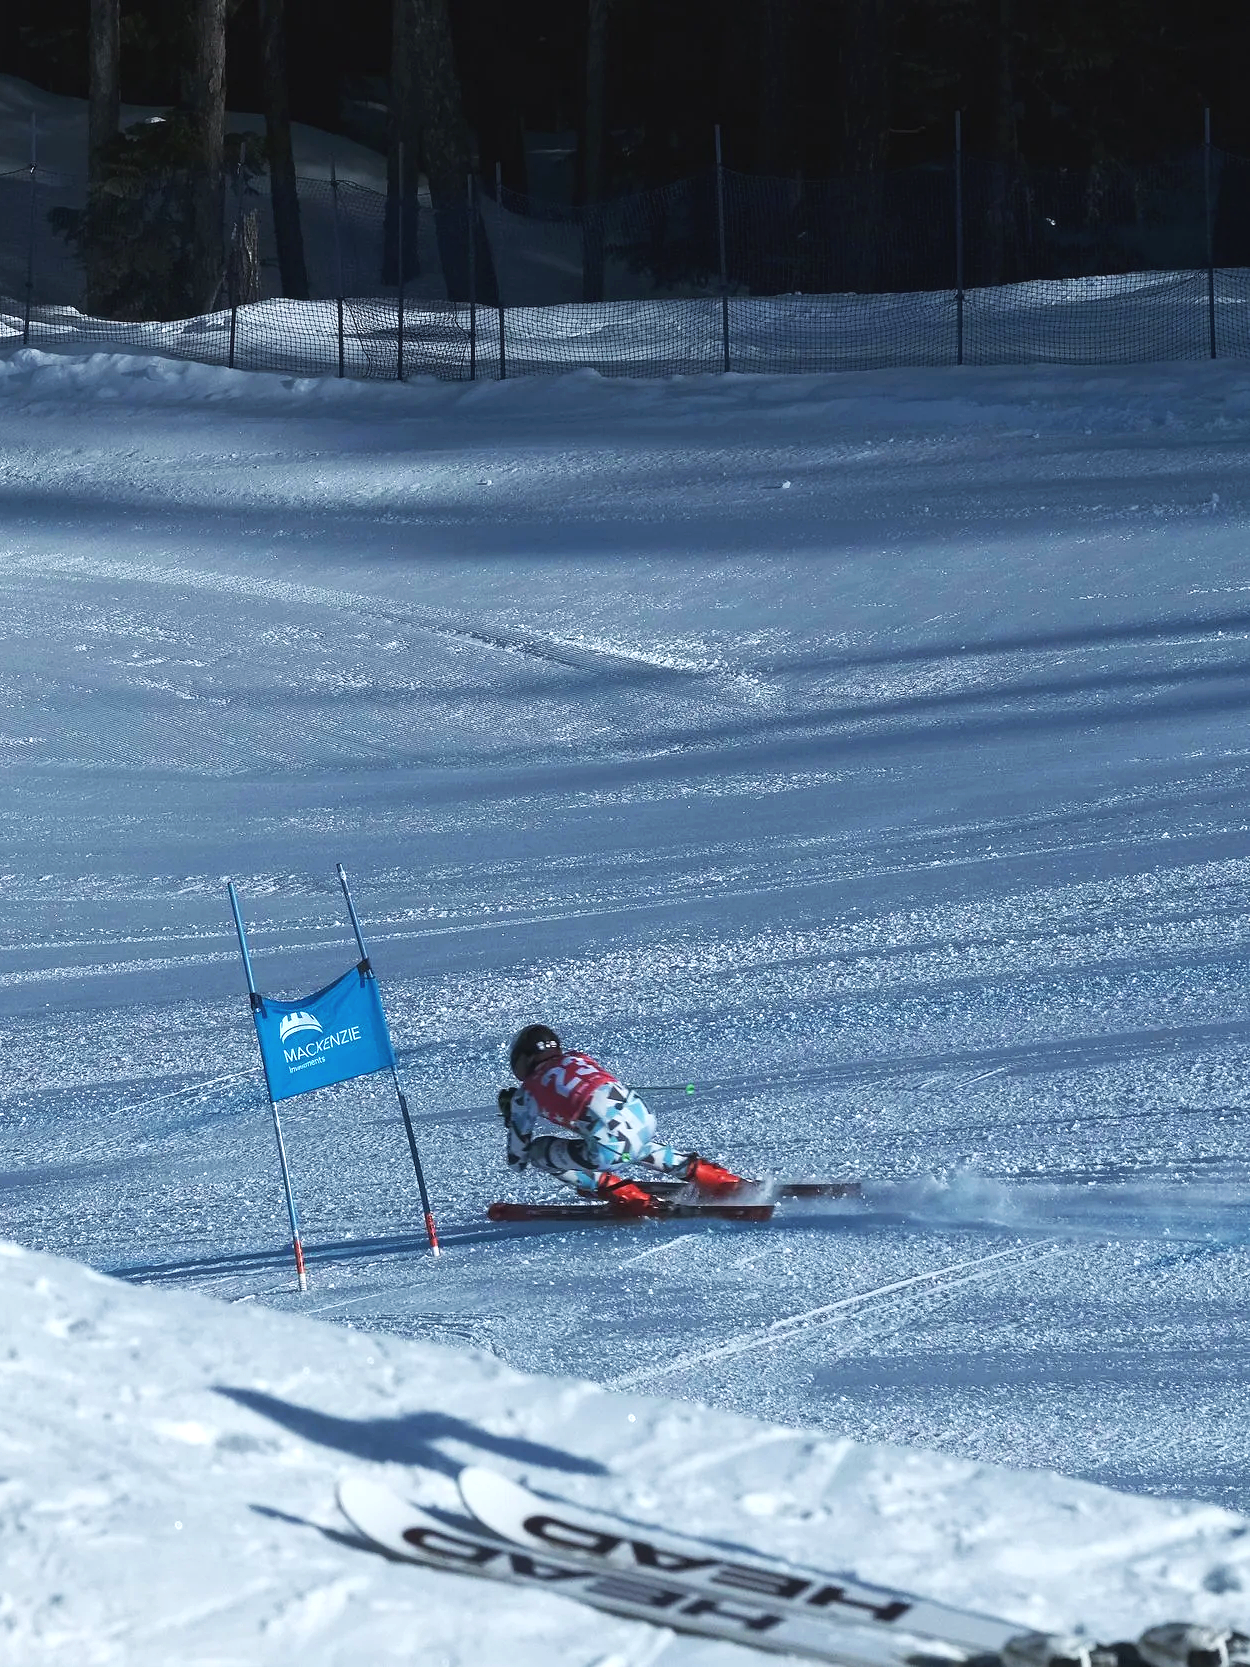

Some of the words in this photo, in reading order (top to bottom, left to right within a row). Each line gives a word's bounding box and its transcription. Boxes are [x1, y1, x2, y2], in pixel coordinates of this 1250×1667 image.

[283, 1026, 362, 1063] MACKENZIE
[402, 1526, 786, 1632] HEAD
[523, 1515, 912, 1622] HEAD
